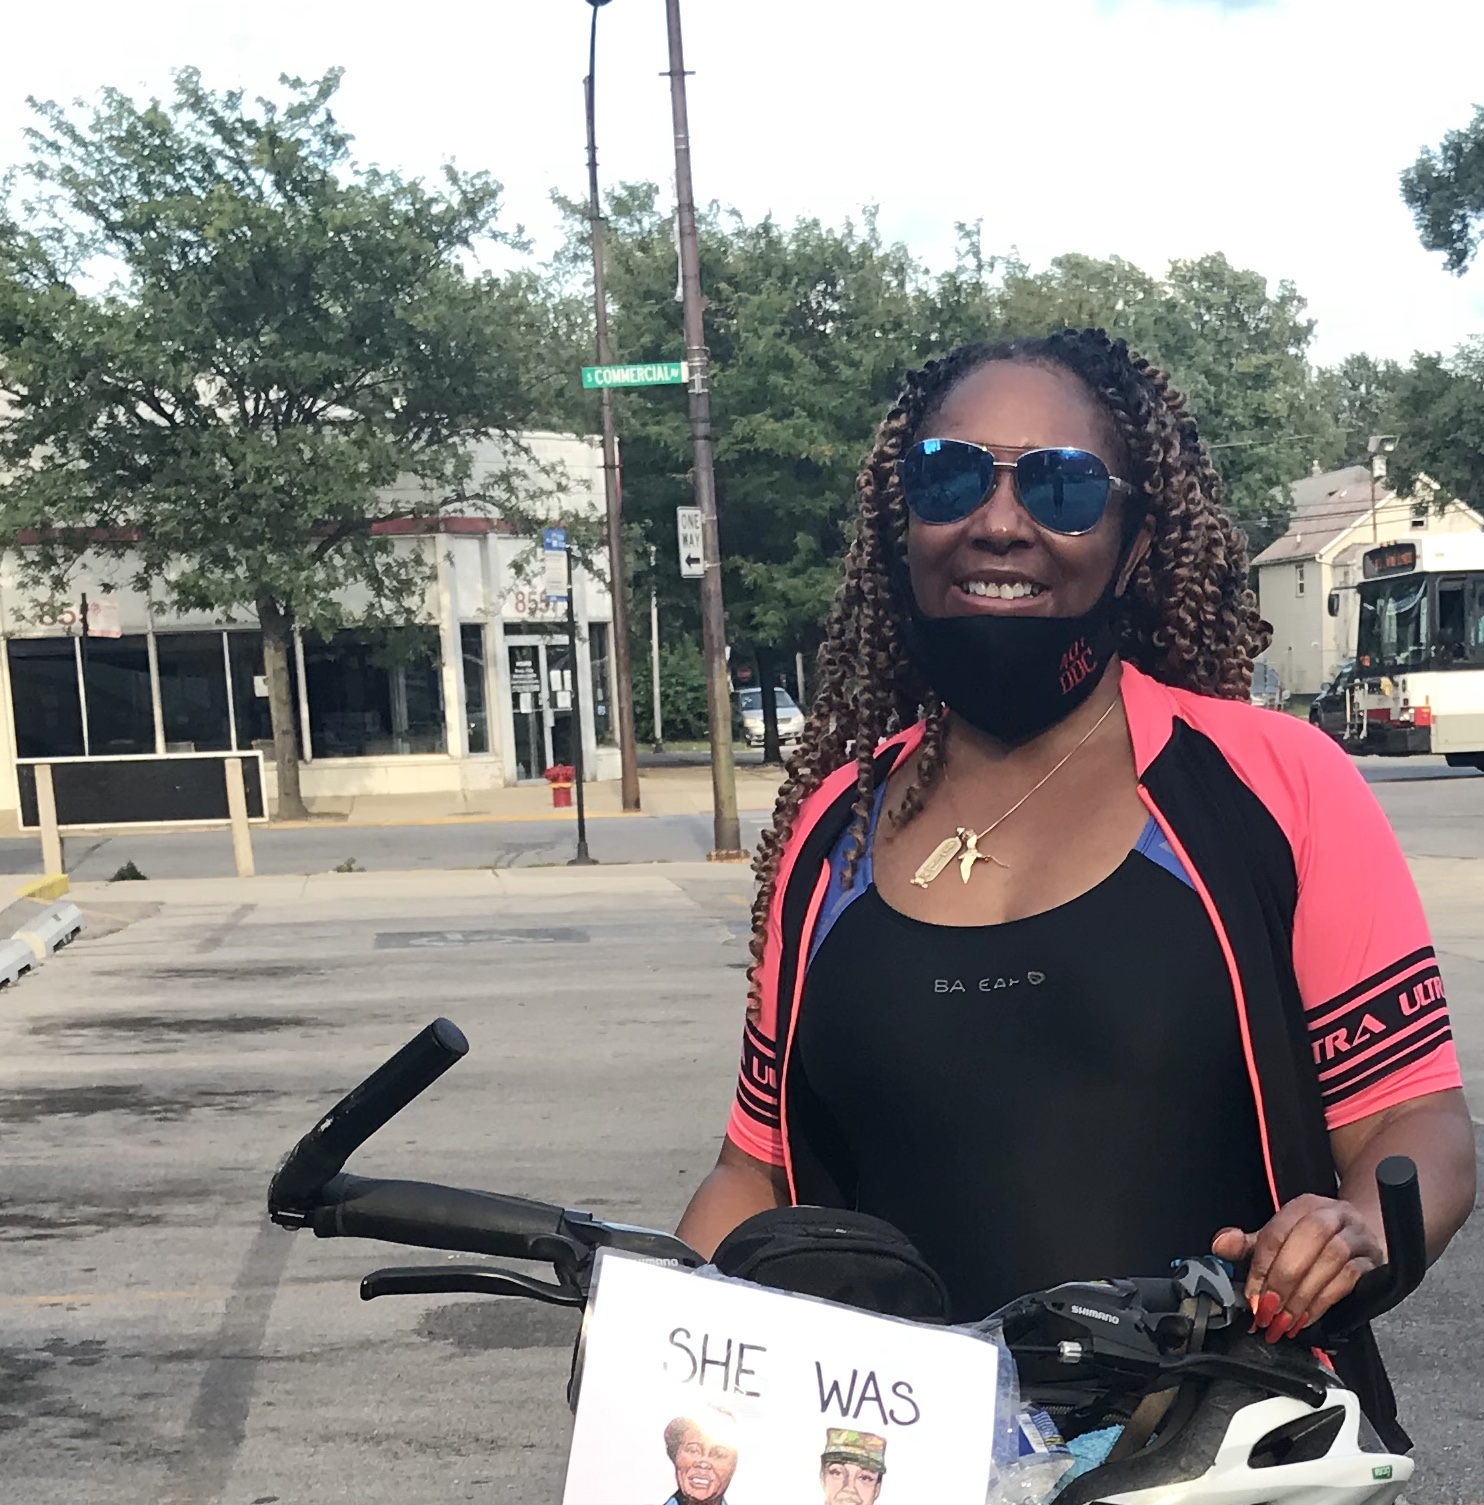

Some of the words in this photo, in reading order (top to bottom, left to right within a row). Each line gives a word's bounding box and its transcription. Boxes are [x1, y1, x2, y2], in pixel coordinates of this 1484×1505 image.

[586, 372, 593, 383] S
[594, 365, 671, 385] COMMERCIAL
[681, 513, 700, 529] ONE
[681, 533, 700, 549] WAY
[514, 590, 557, 613] 855
[1071, 1304, 1120, 1325] SHIMANO
[663, 1327, 769, 1398] SHE
[814, 1360, 922, 1426] WAS
